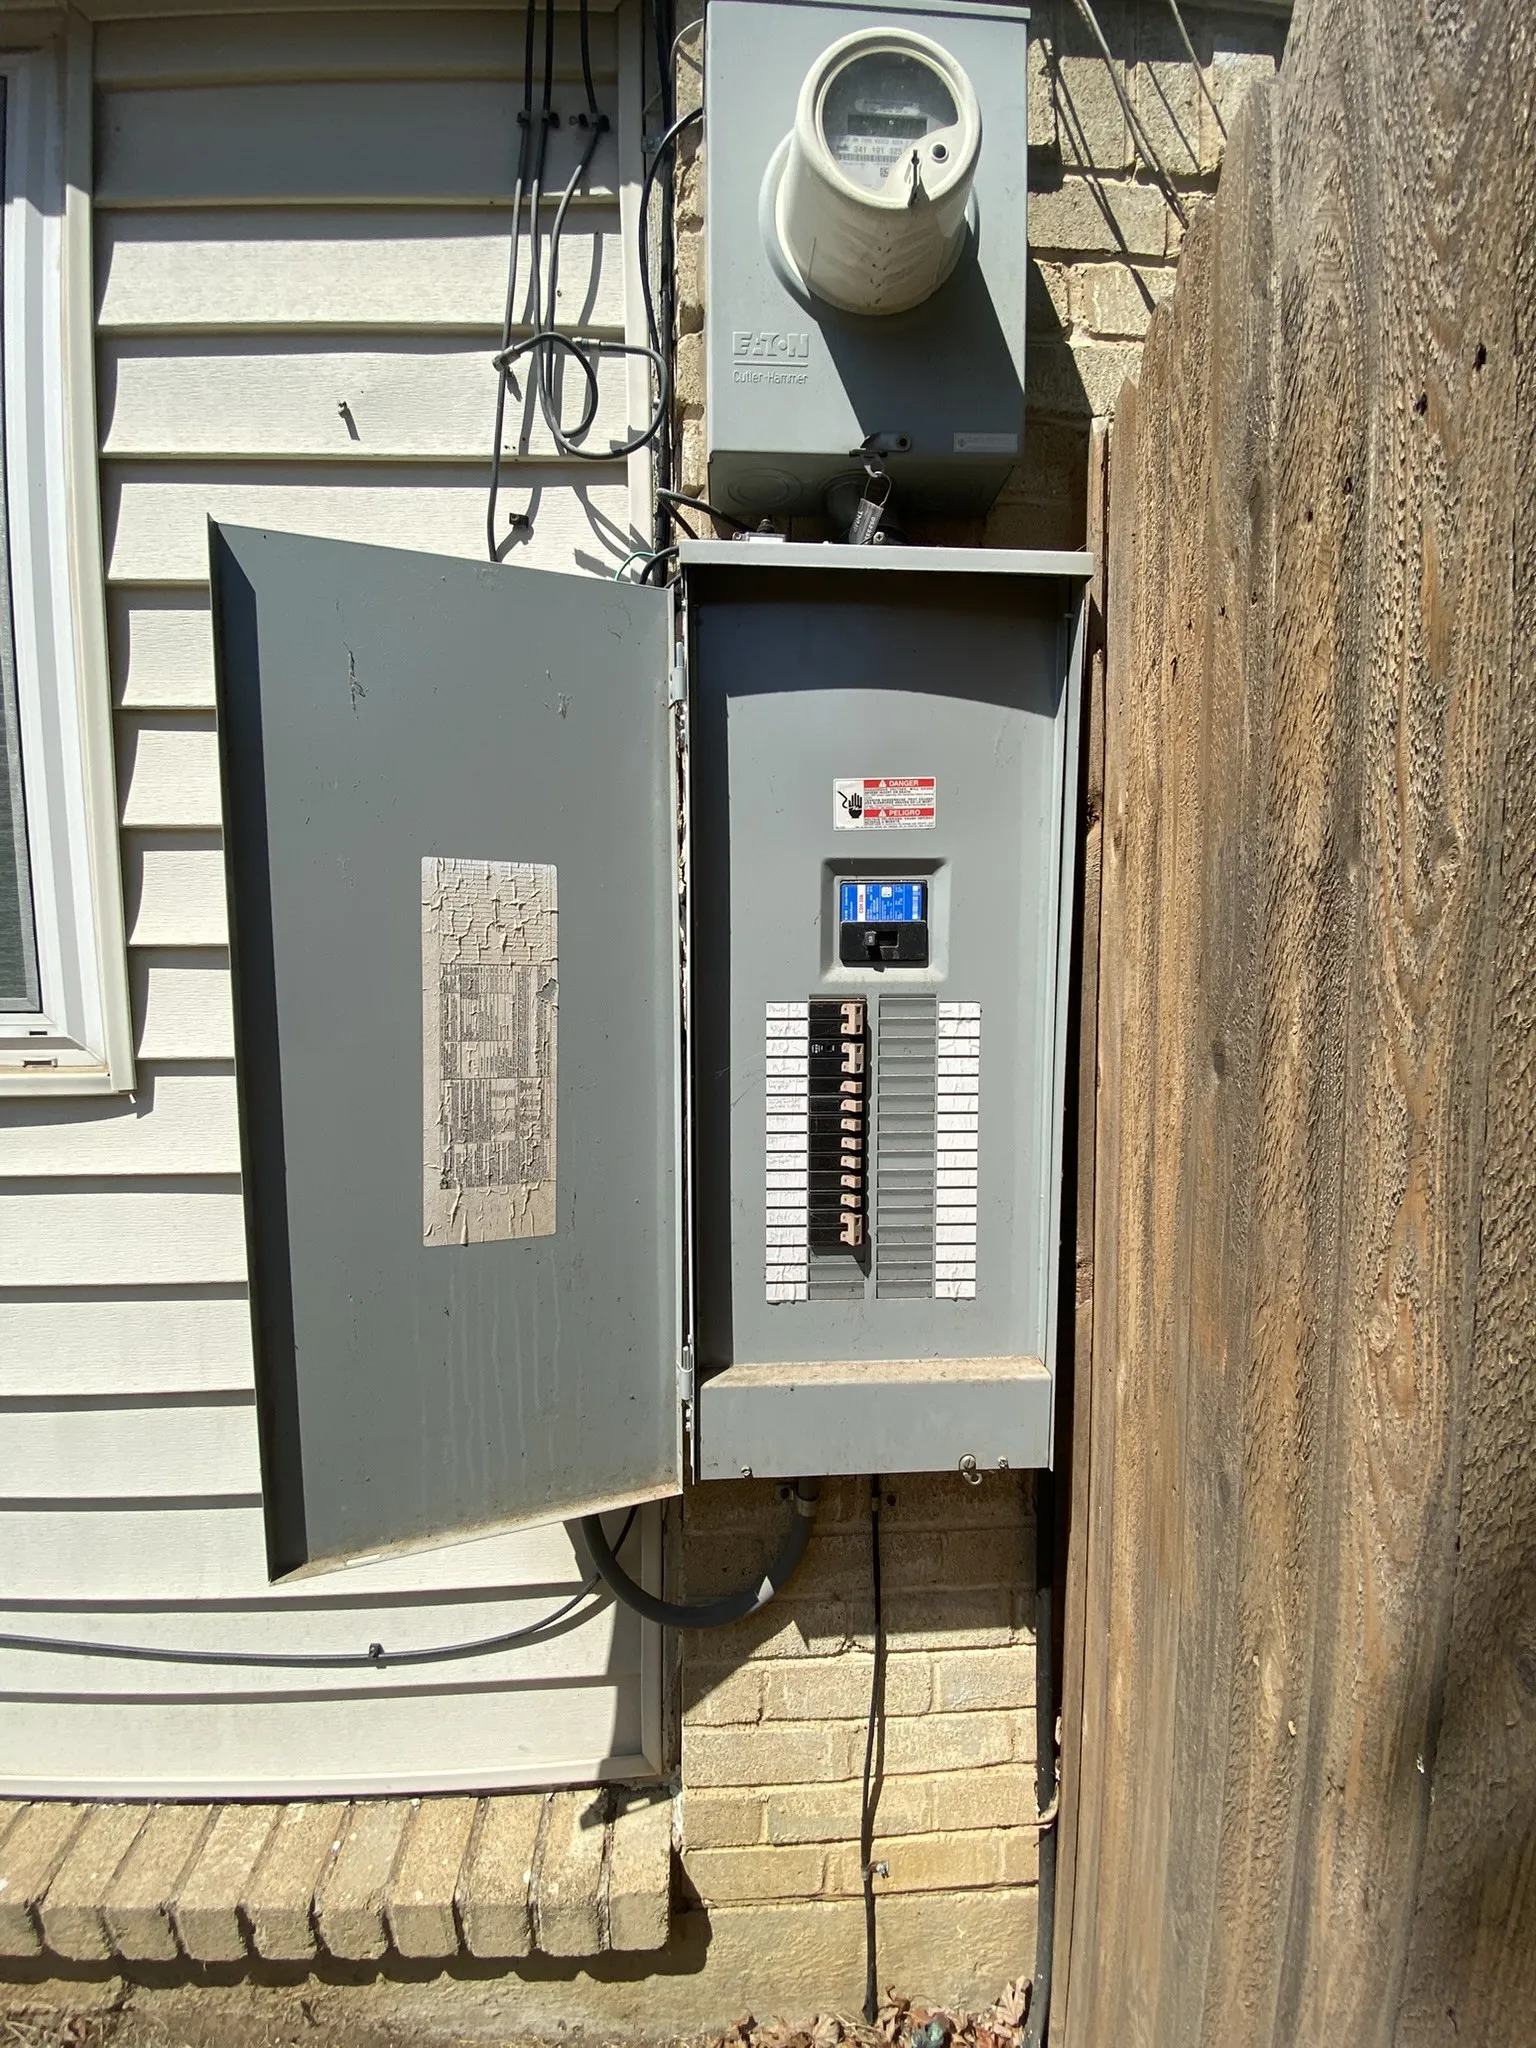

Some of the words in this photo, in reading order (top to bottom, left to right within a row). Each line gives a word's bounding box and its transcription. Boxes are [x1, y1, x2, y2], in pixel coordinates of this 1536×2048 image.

[732, 331, 810, 358] EATON
[733, 370, 808, 385] Cutler-Hammer
[888, 779, 919, 787] DANGER
